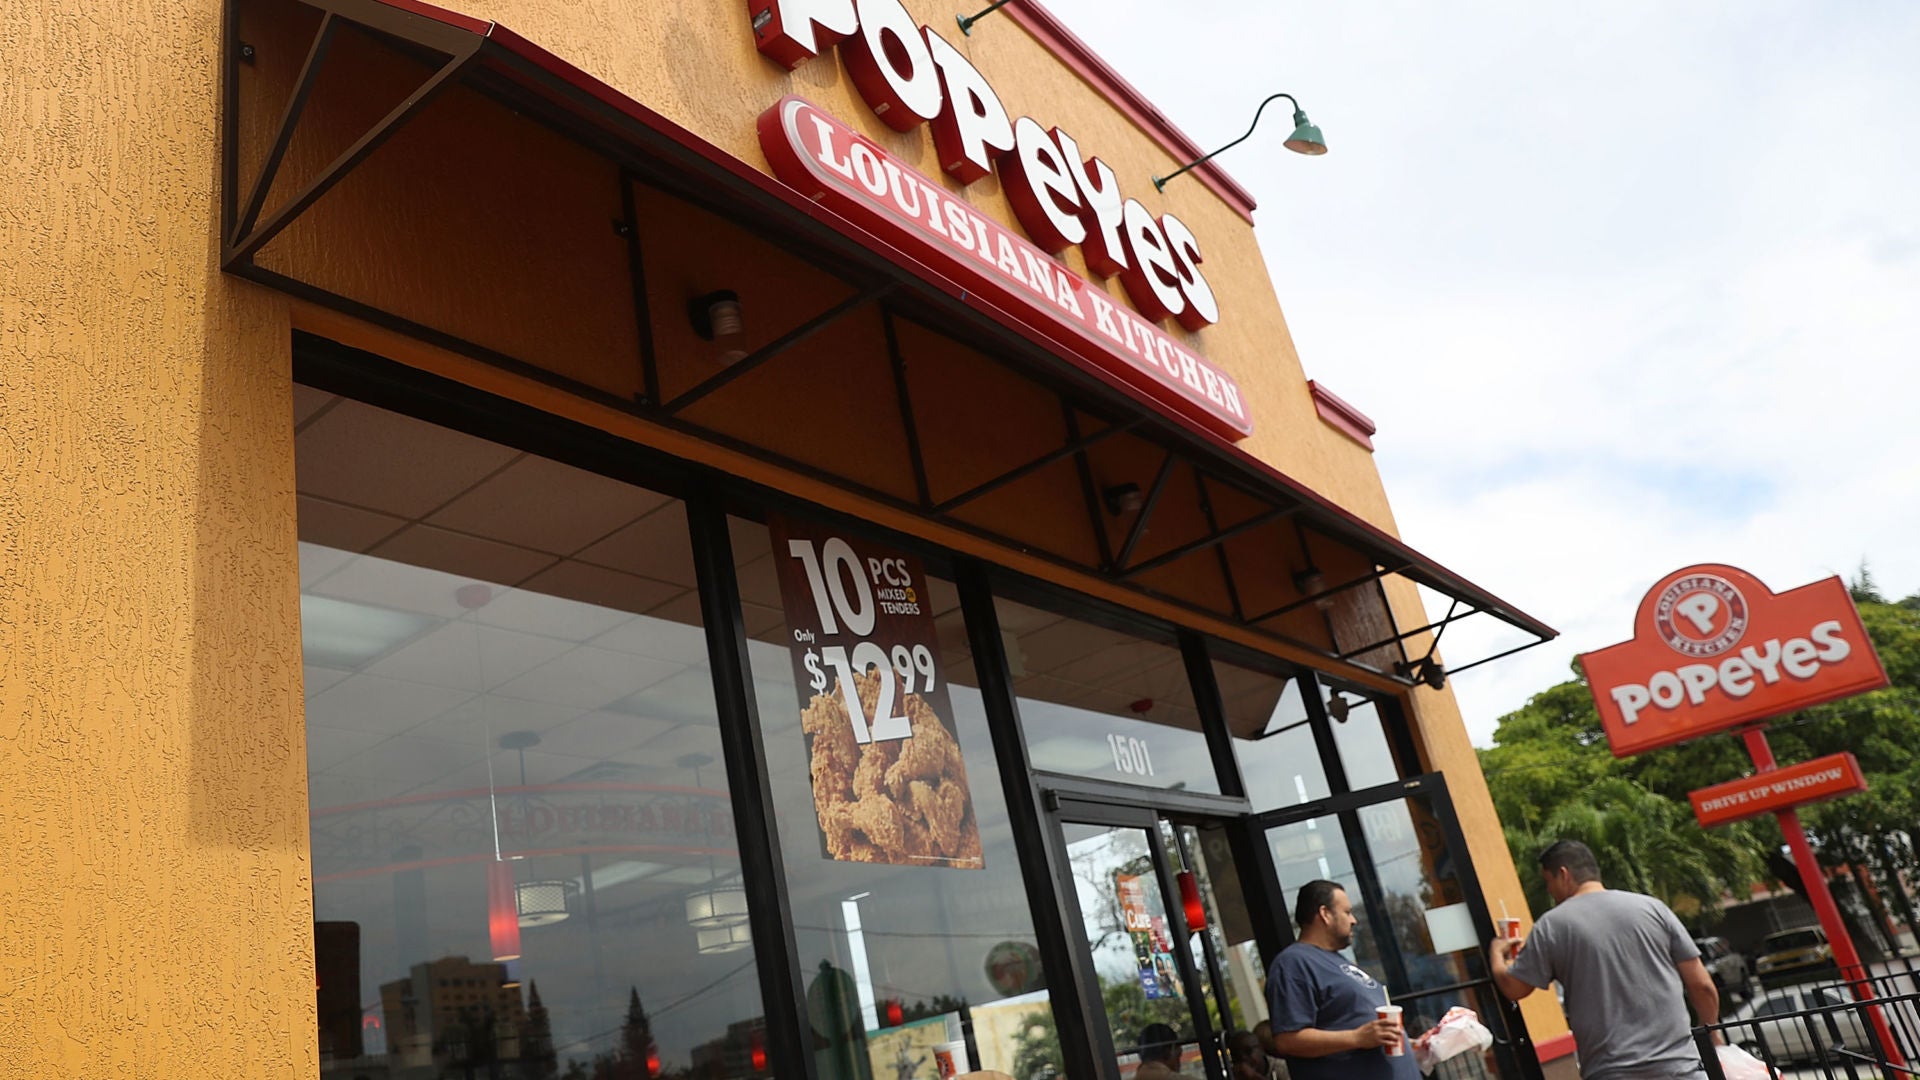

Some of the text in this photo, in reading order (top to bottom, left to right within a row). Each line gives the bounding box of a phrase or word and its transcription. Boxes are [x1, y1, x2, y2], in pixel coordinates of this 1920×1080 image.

[810, 114, 1245, 419] LOUISIANA KITCHEN
[788, 537, 912, 637] 10 PCS
[877, 588, 906, 600] MIXED
[880, 602, 920, 615] TENDERS
[1658, 577, 1736, 621] LOUISIANA
[1676, 593, 1719, 635] P
[794, 629, 816, 644] Only
[1670, 617, 1743, 655] KITCHEN
[1106, 733, 1154, 777] 1501
[1701, 767, 1843, 813] DRIVE UP WINDOW
